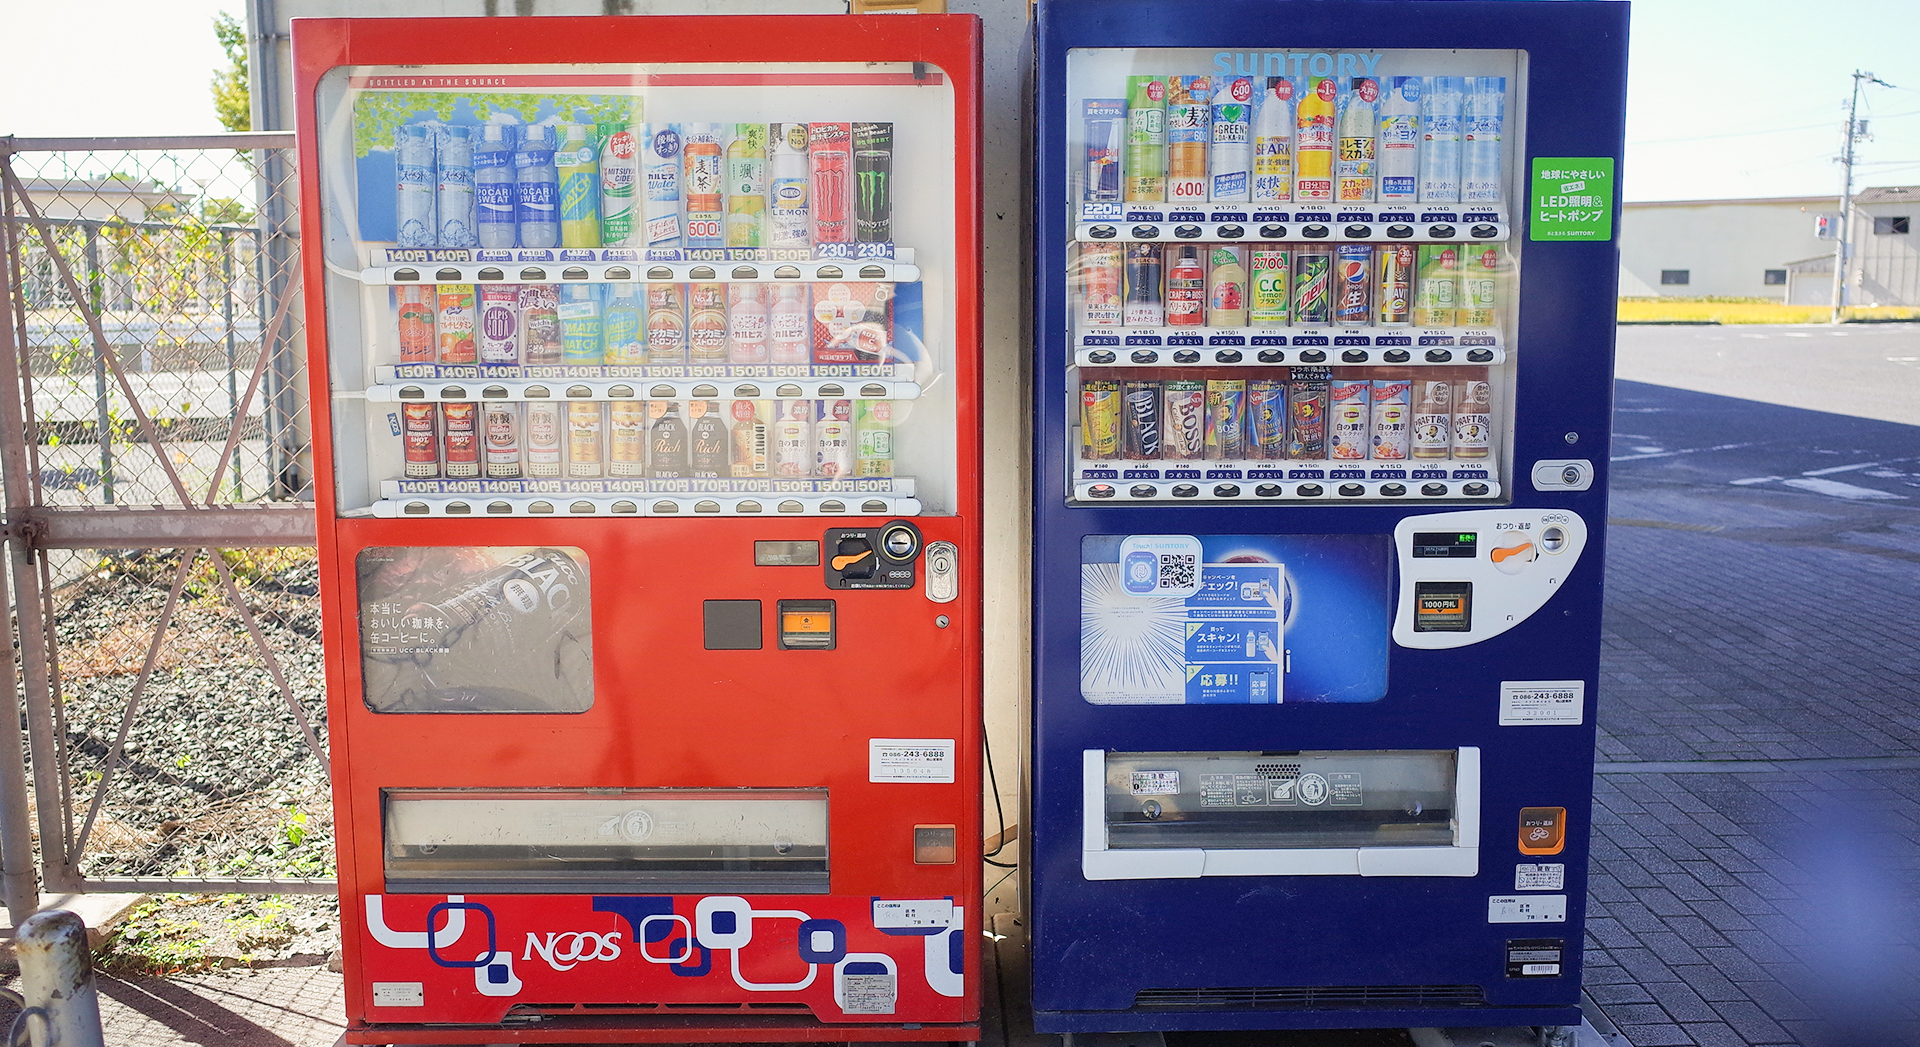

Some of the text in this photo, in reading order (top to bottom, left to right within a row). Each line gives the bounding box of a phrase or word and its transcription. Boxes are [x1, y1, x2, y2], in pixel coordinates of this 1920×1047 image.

[1212, 52, 1383, 76] SUNTORY
[1149, 91, 1165, 99] 京都
[1232, 84, 1250, 95] 600
[1187, 106, 1209, 128] 麦茶
[811, 125, 840, 134] トロピカル
[1217, 124, 1245, 136] GREEN
[612, 134, 632, 146] スッキリ
[657, 133, 676, 144] 後味
[1345, 139, 1371, 149] レモン
[613, 143, 636, 156] 爽快
[656, 143, 678, 154] すっきり
[1089, 148, 1119, 158] Red Bull
[1255, 143, 1291, 155] SPARK
[695, 159, 712, 193] 麦茶
[1540, 170, 1606, 180] 地球にやさしい
[648, 179, 676, 191] Water
[1215, 180, 1245, 192] スポドリ!
[1256, 175, 1281, 190] 爽快
[1300, 181, 1319, 189] 1日分
[478, 188, 512, 196] POCARI
[519, 188, 553, 196] POCARI
[1256, 188, 1279, 199] レモン
[478, 195, 510, 203] SWEAT
[520, 195, 551, 203] SWEAT
[1540, 195, 1604, 207] LED照明&
[1084, 203, 1121, 215] 220円
[1540, 209, 1604, 222] ヒートポンプ
[688, 222, 718, 237] 600
[387, 250, 427, 262] 140円
[429, 250, 469, 262] 140円
[685, 249, 725, 260] 140円
[727, 249, 767, 260] 150円
[770, 249, 811, 260] 130円
[858, 243, 894, 257] 230円
[1259, 279, 1284, 292] C.C.
[487, 310, 509, 320] CALPIS
[1087, 311, 1117, 319] 贅沢な甘さ
[1344, 306, 1363, 314] COLA
[487, 319, 510, 337] SODA
[732, 320, 765, 329] いちごオレ
[692, 329, 727, 338] ドデカミン
[650, 338, 678, 346] ストロング
[696, 338, 724, 346] ストロング
[396, 366, 436, 378] 150円
[437, 366, 480, 378] 140円
[481, 366, 521, 378] 140円
[525, 366, 564, 378] 150円
[606, 366, 643, 378] 150円
[687, 365, 727, 377] 150円
[729, 365, 768, 377] 150円
[771, 365, 810, 377] 150円
[812, 365, 853, 377] 150円
[854, 365, 895, 377] 150円
[1209, 392, 1222, 406] 新
[735, 402, 752, 410] 直火
[834, 405, 850, 414] 濃厚
[489, 413, 511, 424] 特製
[658, 423, 677, 432] BLACK
[697, 423, 716, 432] BLACK
[1216, 421, 1239, 433] BOSS
[1336, 423, 1365, 431] 白の贅沢
[1377, 423, 1406, 431] 白の贅沢
[653, 439, 681, 453] Rich
[694, 439, 721, 454] Rich
[755, 426, 765, 470] DOUTOR
[399, 481, 440, 493] 140円
[441, 481, 480, 493] 140円
[481, 481, 521, 493] 140円
[522, 481, 561, 493] 140円
[563, 481, 604, 493] 140円
[605, 481, 644, 493] 140円
[650, 480, 689, 491] 170円
[692, 480, 730, 491] 170円
[731, 480, 770, 491] 170円
[774, 481, 813, 492] 150円
[815, 481, 855, 492] 150円
[1496, 522, 1532, 530] おつり・返却
[369, 602, 402, 616] 本当に
[1424, 600, 1456, 608] 1000円札
[369, 616, 452, 631] おいしい珈琲を、
[369, 631, 436, 645] 缶コーヒーに。
[1197, 633, 1240, 643] スキャン!
[1200, 673, 1239, 686] 応募!!
[1251, 688, 1267, 696] 完了
[522, 931, 622, 971] NOOS
